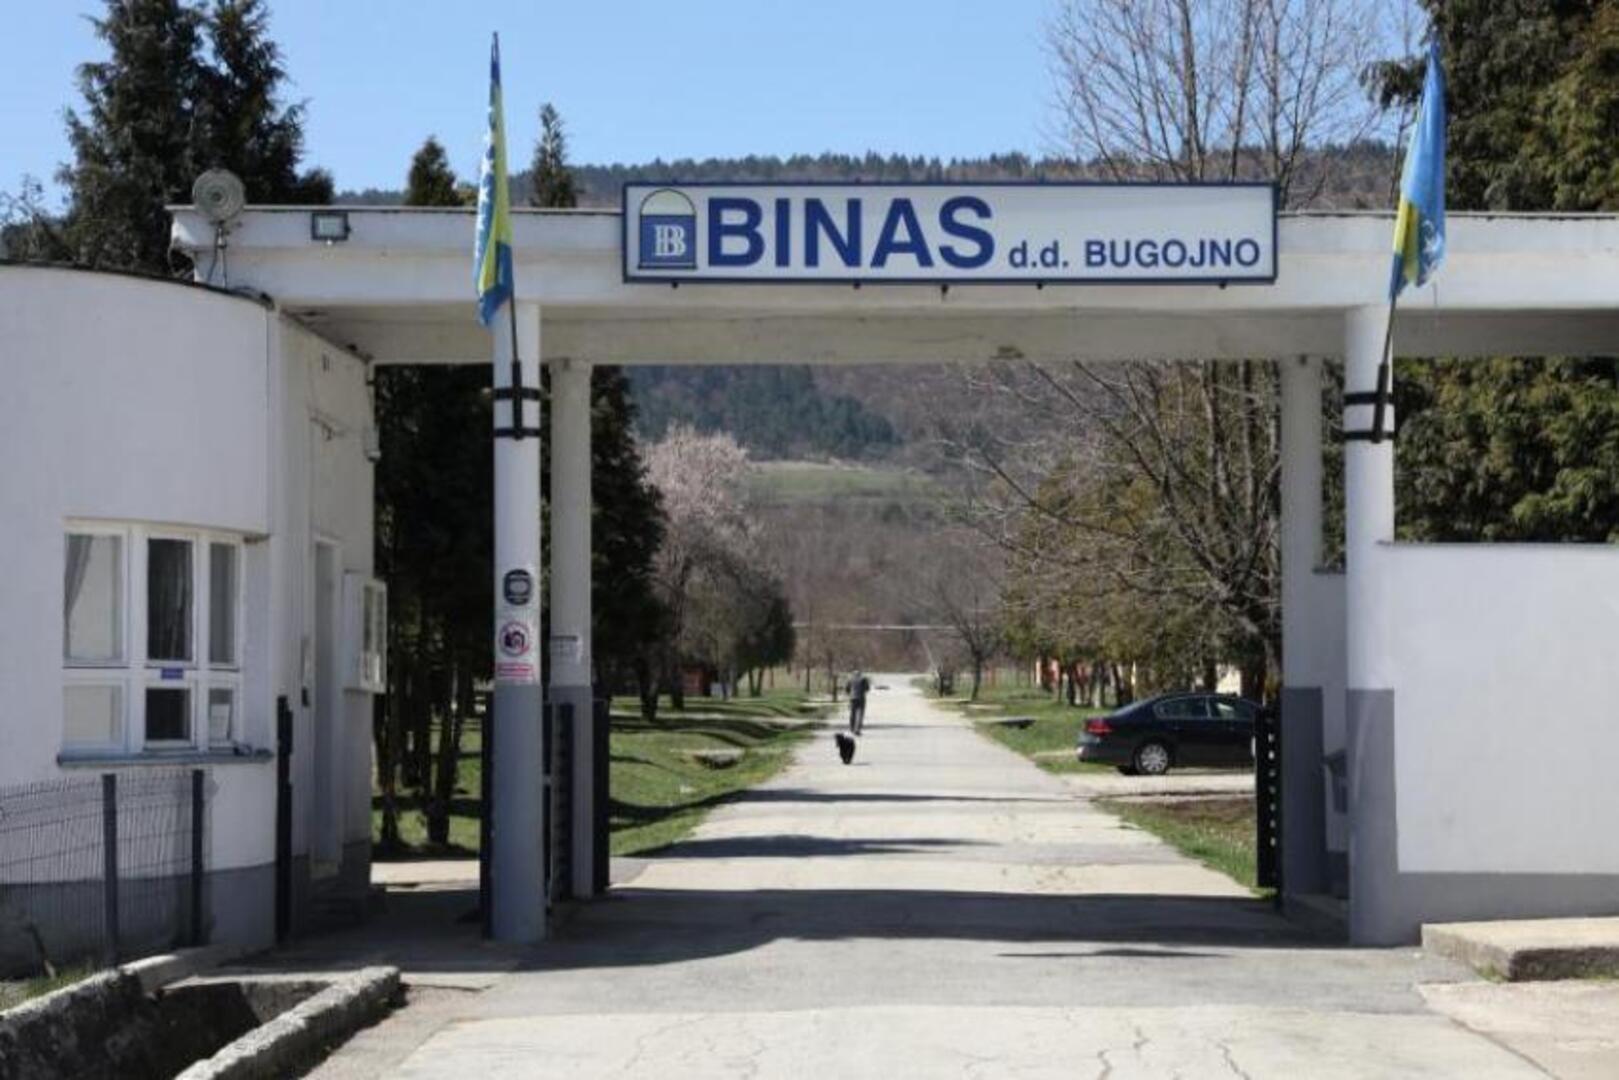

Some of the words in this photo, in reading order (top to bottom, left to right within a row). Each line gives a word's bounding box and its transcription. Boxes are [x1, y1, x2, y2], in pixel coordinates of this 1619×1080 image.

[707, 195, 995, 270] BINAS
[1008, 240, 1069, 269] d.d.
[1085, 238, 1261, 268] BUGOJNO
